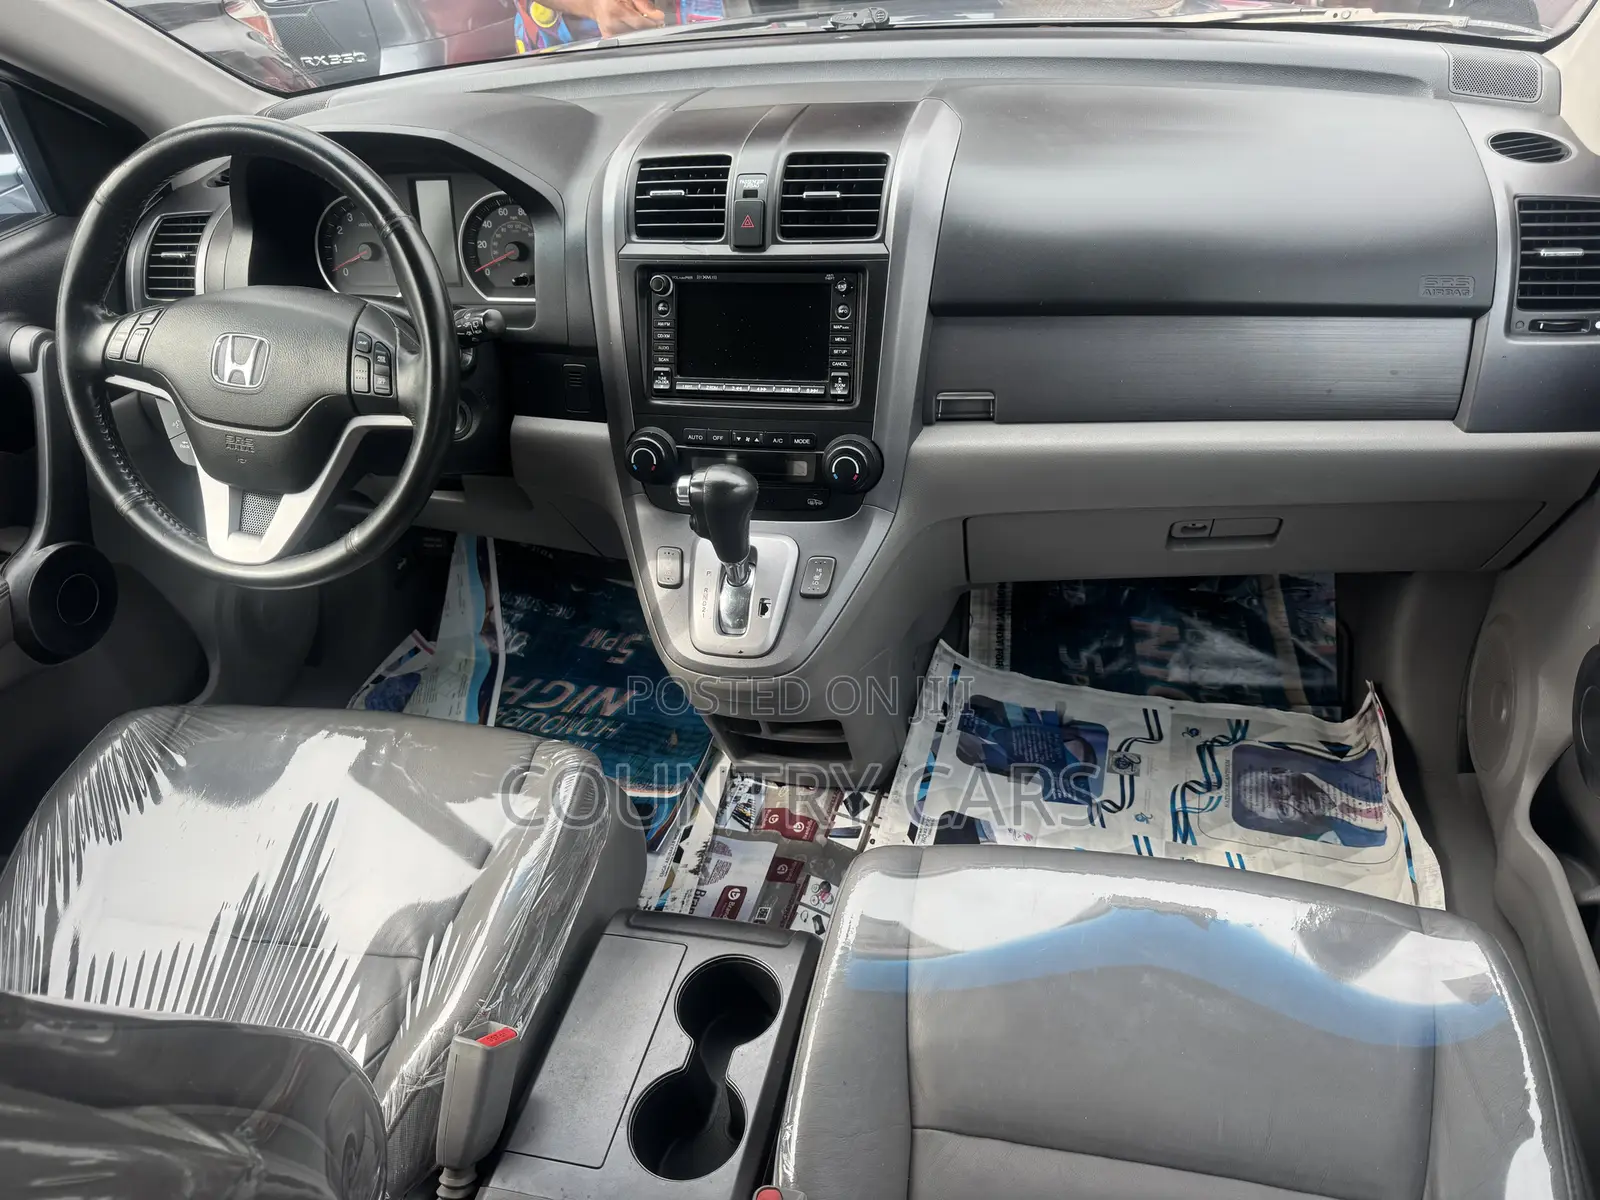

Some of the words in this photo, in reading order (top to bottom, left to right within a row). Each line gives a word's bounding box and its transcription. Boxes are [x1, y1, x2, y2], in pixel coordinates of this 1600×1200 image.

[498, 207, 508, 216] 60
[347, 213, 353, 222] 3
[482, 220, 492, 228] 40
[337, 226, 344, 235] 2
[477, 240, 487, 248] 20
[343, 267, 349, 276] 0
[484, 268, 490, 276] 0
[1425, 277, 1470, 287] SRS
